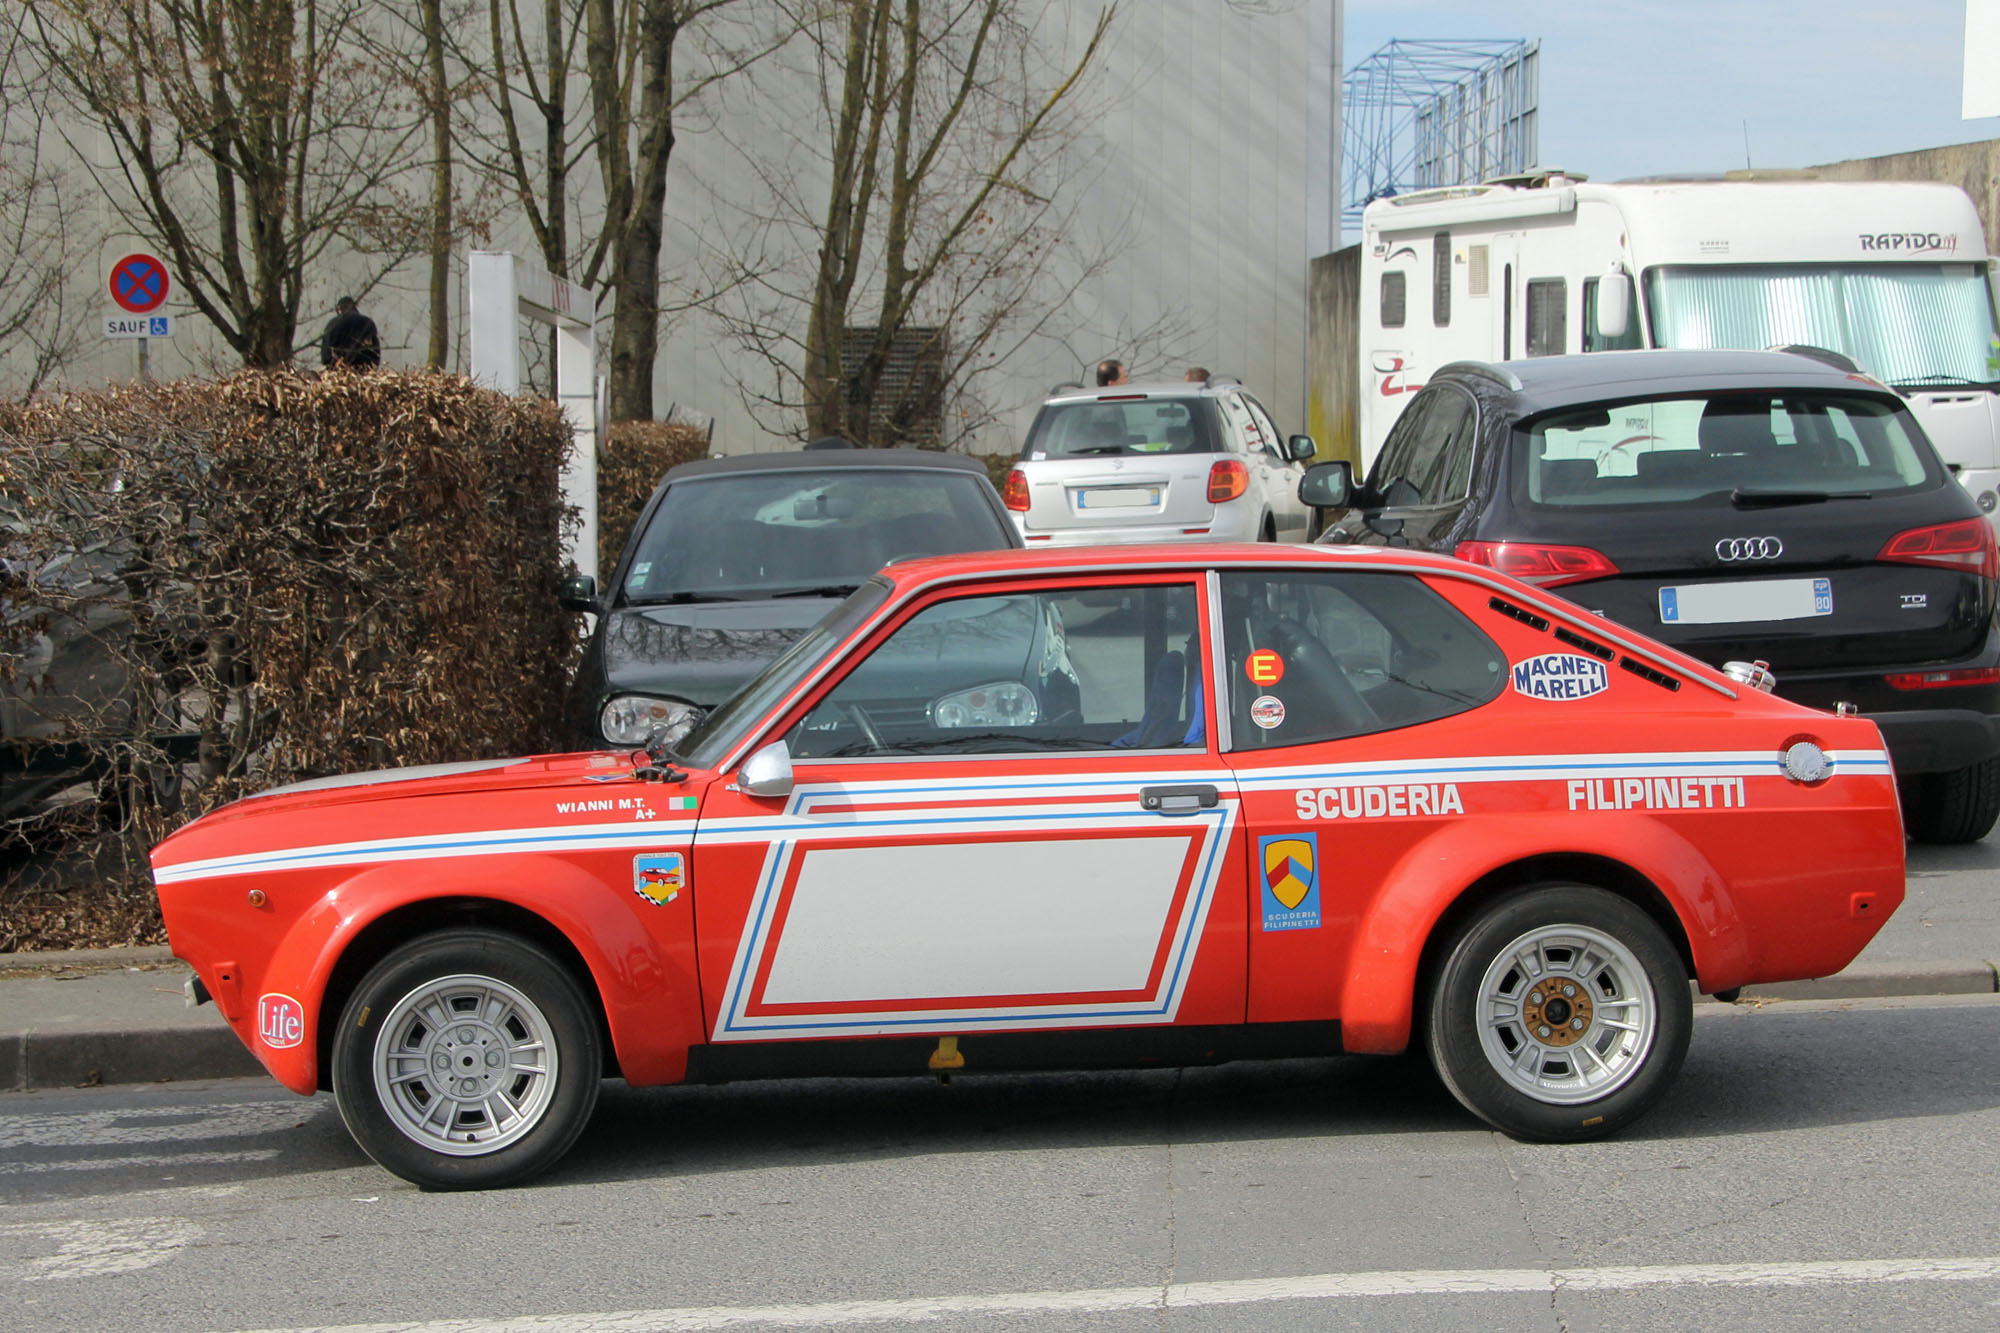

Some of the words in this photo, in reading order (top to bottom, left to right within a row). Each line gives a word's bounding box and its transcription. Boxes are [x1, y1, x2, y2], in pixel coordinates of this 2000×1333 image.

[108, 320, 147, 334] SAUF
[1816, 596, 1830, 610] 80
[1900, 594, 1927, 603] TDI
[1252, 655, 1277, 680] E
[1514, 655, 1607, 684] MAGNETI
[1514, 670, 1607, 699] MARELLI
[1295, 783, 1465, 820] SCUDERIA
[1567, 776, 1746, 811] FILIPINETTI
[556, 799, 613, 814] WIANNI
[618, 798, 646, 809] M.T.
[635, 809, 656, 820] A+
[1268, 911, 1317, 921] SCUDERIA
[1264, 919, 1320, 929] FILIPINETTI
[261, 1001, 301, 1040] Life
